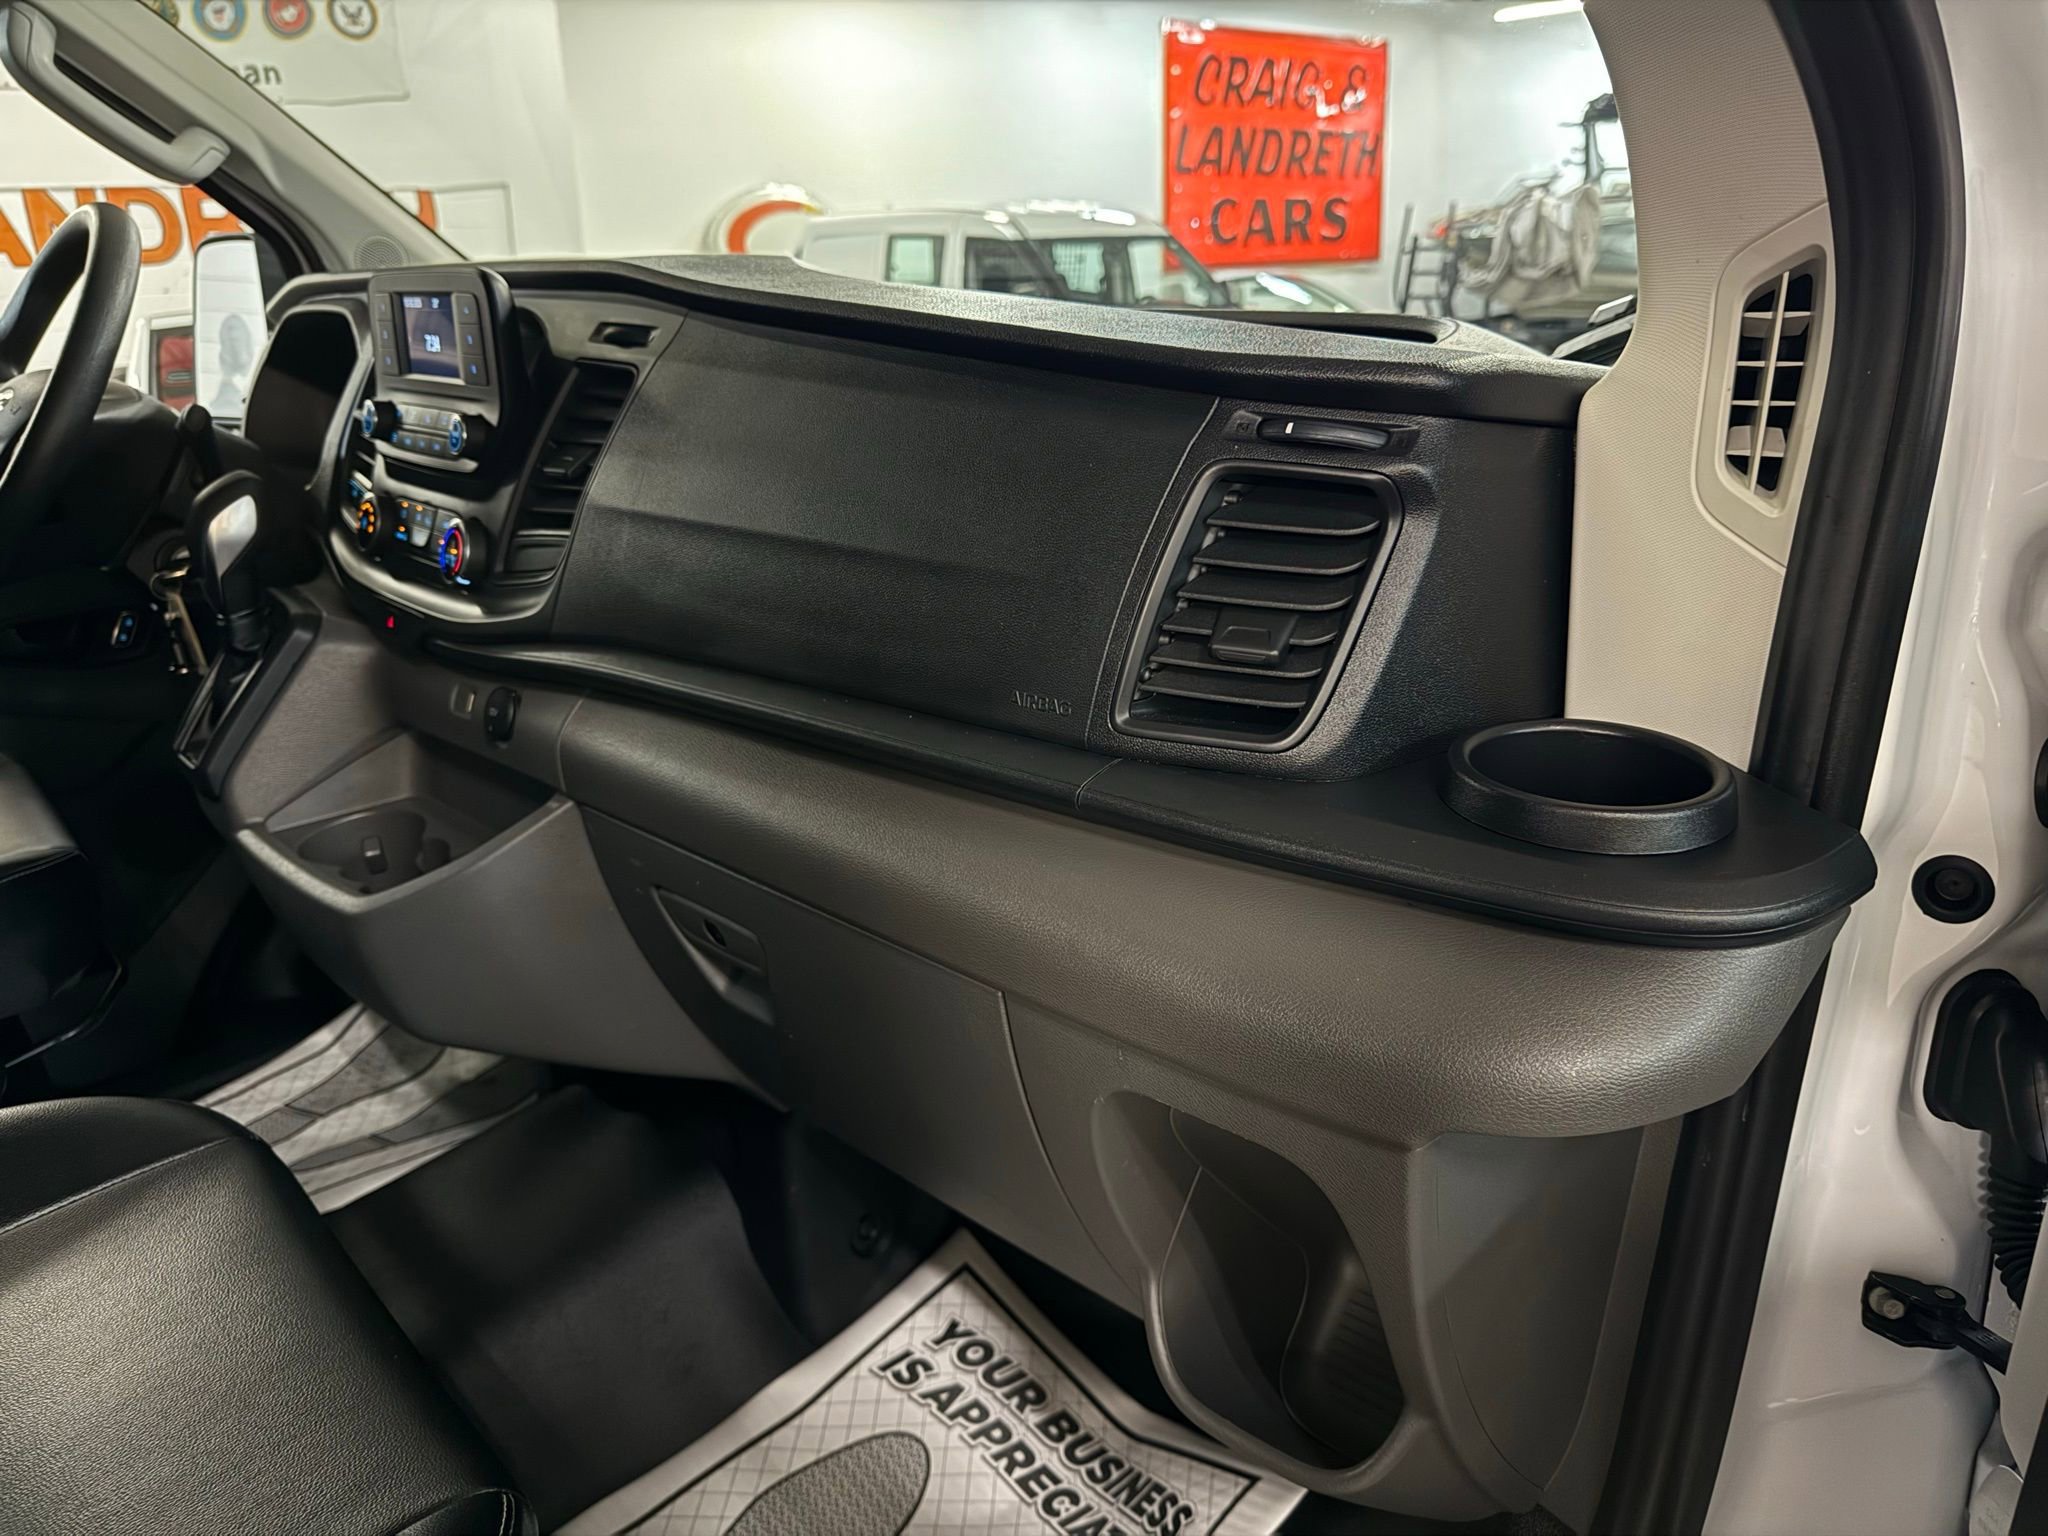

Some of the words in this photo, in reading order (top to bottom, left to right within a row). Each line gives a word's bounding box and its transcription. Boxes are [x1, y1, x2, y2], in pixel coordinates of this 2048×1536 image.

[1194, 54, 1320, 109] CRAIG
[1341, 64, 1367, 111] &
[1175, 124, 1382, 178] LANDRETH
[1210, 197, 1349, 246] CARS
[1010, 690, 1072, 717] AIRBAG
[877, 1349, 935, 1386] IS
[919, 1382, 1127, 1536] APPRECIA
[930, 1318, 1048, 1413] YOUR
[1035, 1408, 1194, 1536] BUSINESS
